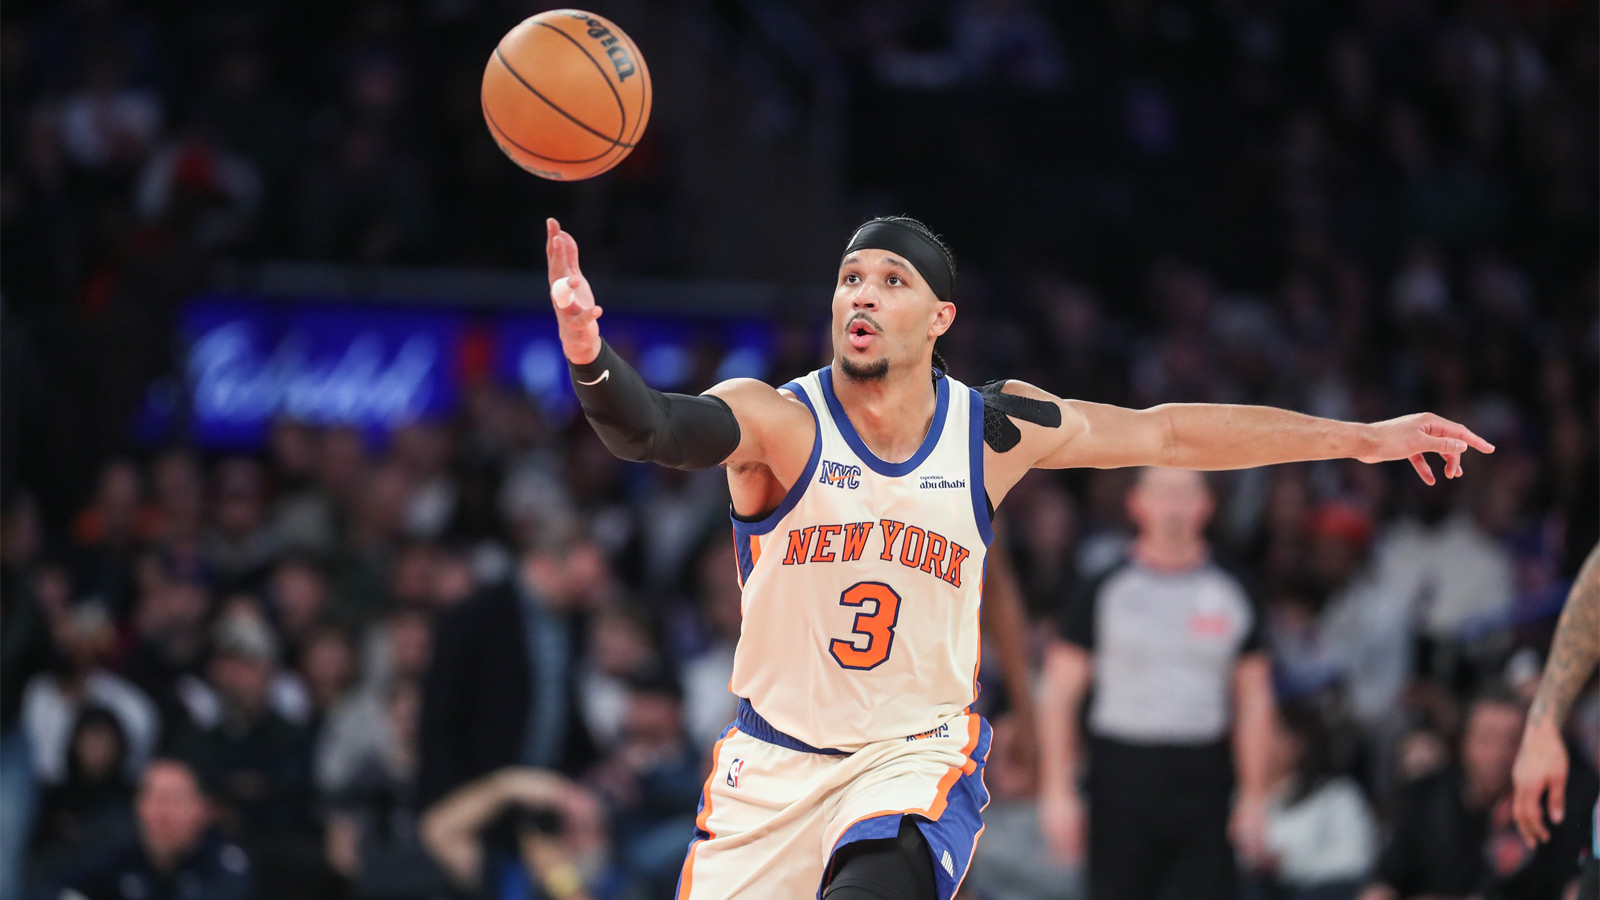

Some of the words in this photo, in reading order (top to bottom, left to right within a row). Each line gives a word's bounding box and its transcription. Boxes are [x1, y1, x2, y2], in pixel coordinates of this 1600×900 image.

[560, 10, 635, 83] Wilso
[819, 460, 862, 490] NYC
[919, 480, 937, 489] abu
[938, 479, 966, 489] dhabi
[782, 521, 875, 566] NEW
[880, 519, 970, 588] YORK
[828, 581, 902, 671] 3
